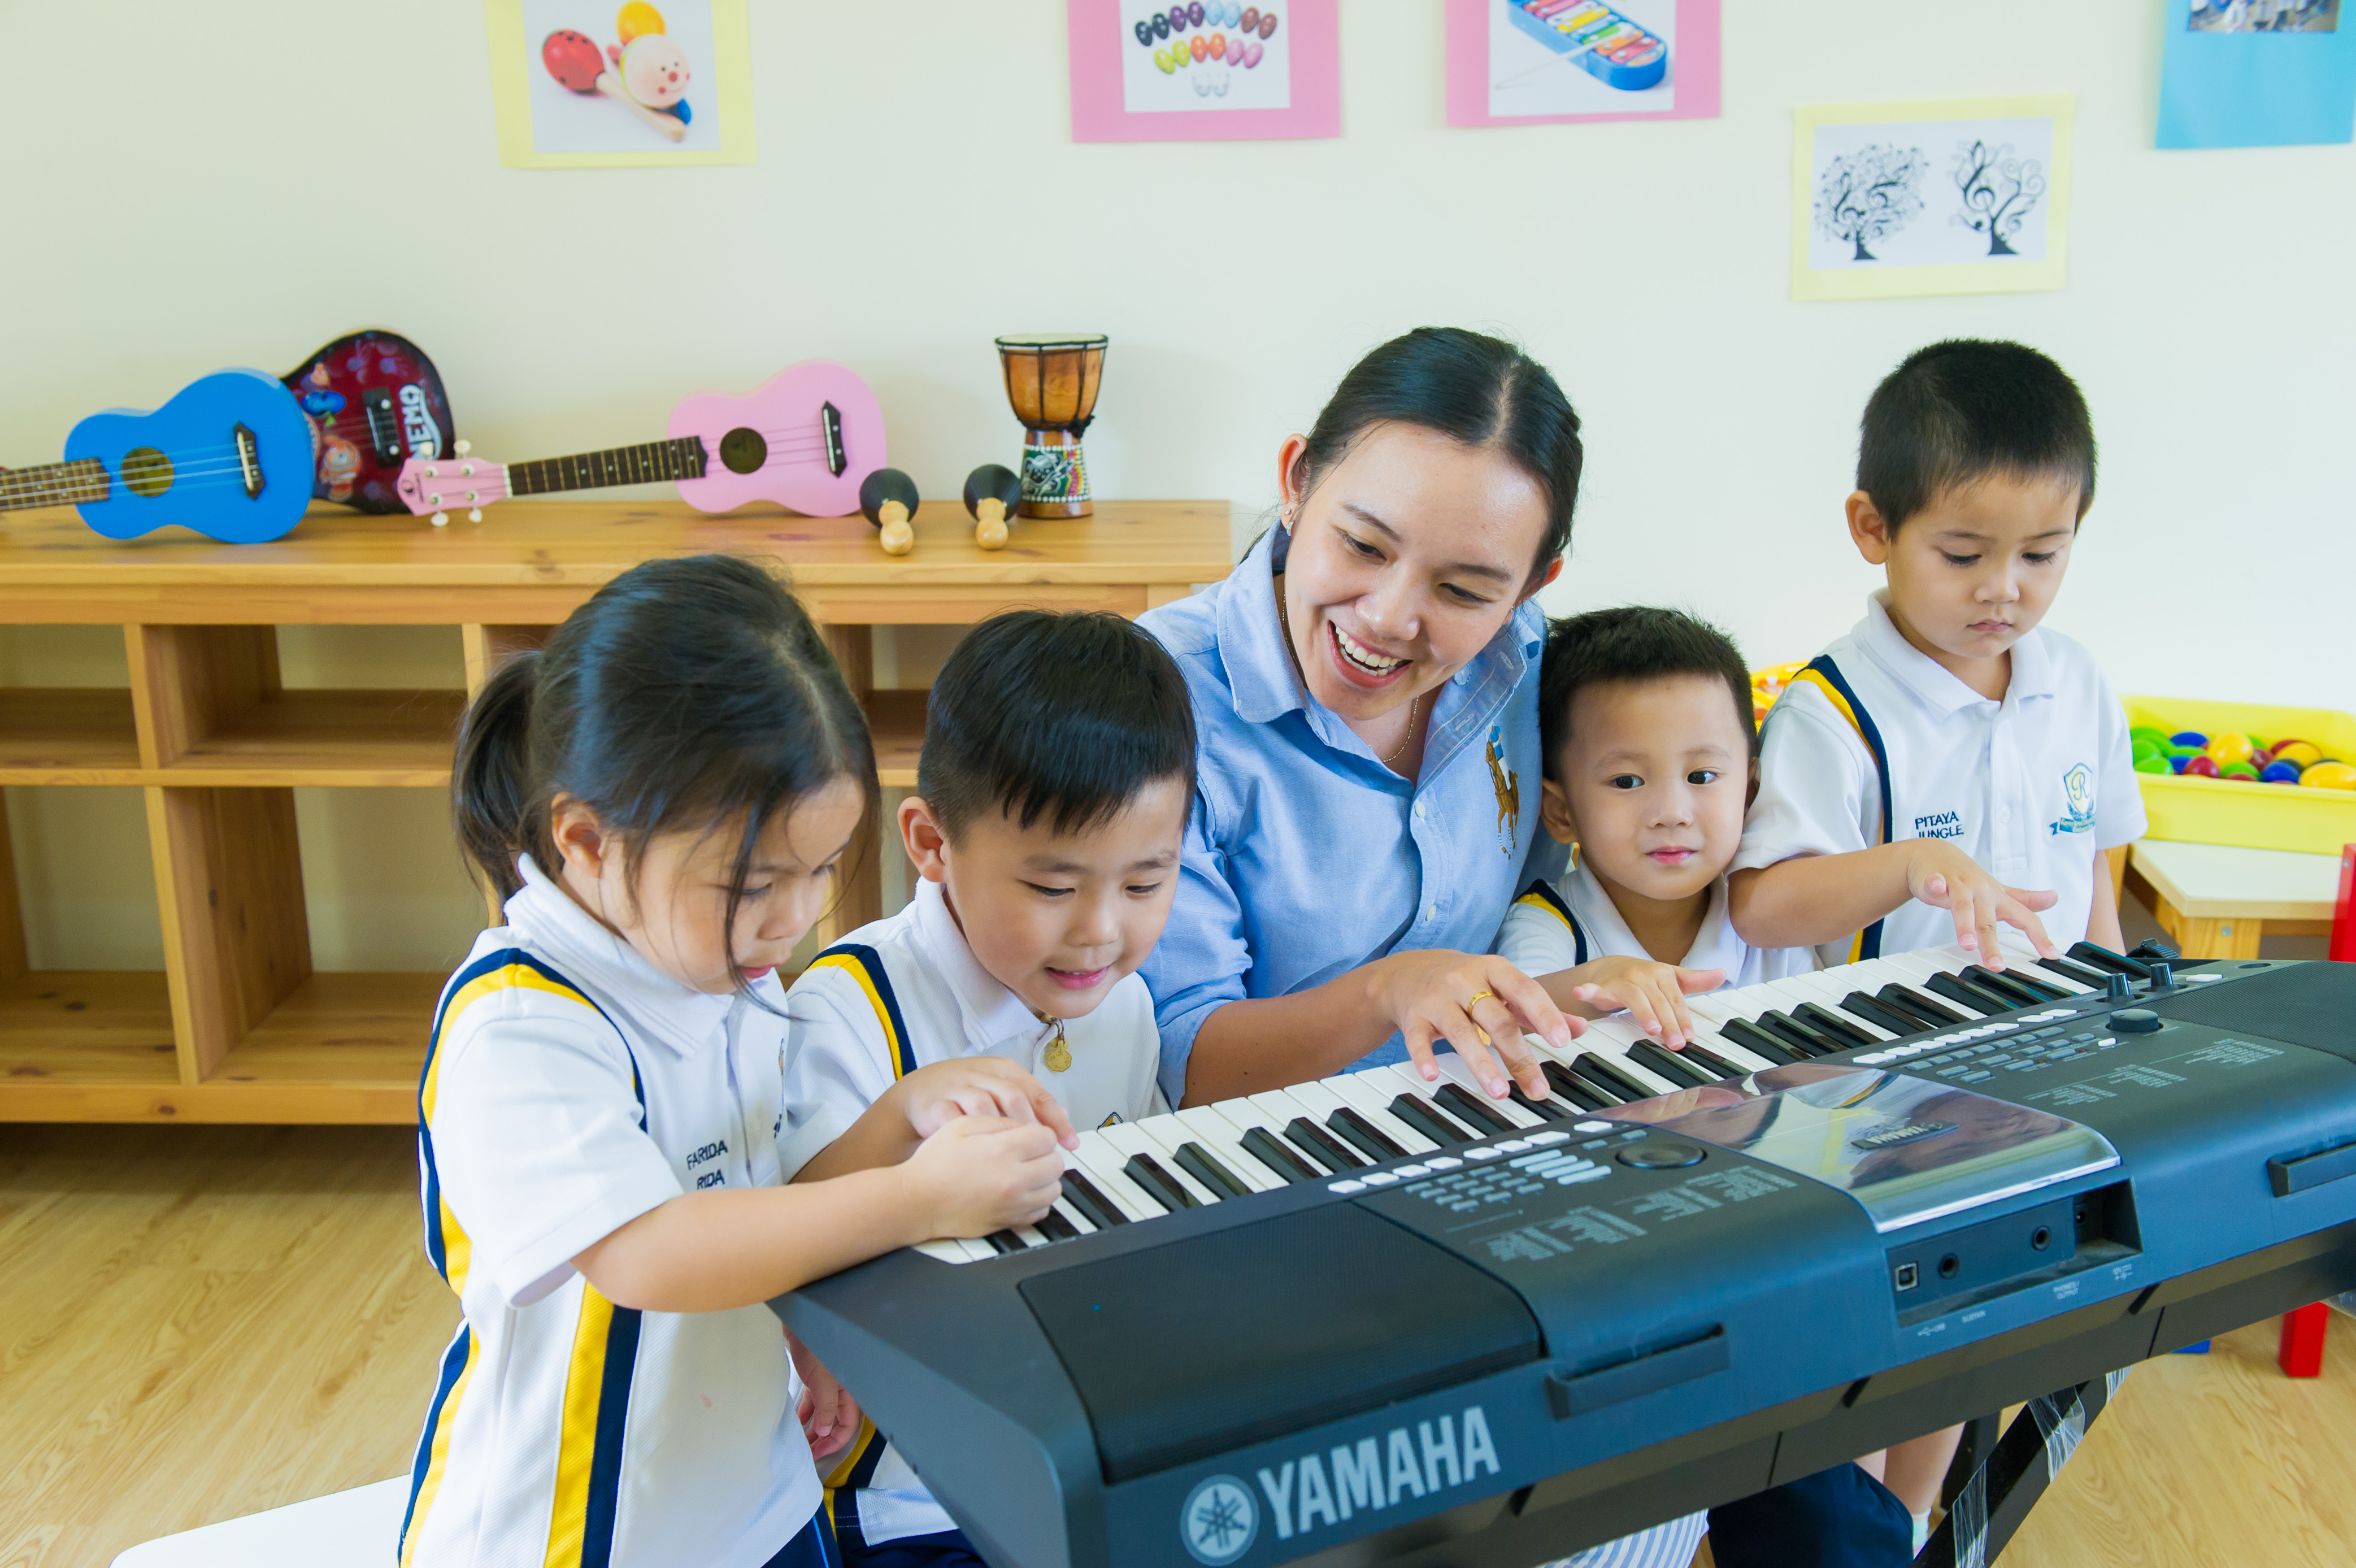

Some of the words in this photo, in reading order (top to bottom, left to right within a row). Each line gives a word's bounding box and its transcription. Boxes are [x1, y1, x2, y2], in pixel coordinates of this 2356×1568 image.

[1915, 811, 1959, 829] PITAYA
[1919, 824, 1964, 839] JUNGLE
[686, 1140, 729, 1170] FARIDA
[697, 1169, 725, 1190] RIDA
[1257, 1405, 1500, 1540] YAMAHA
